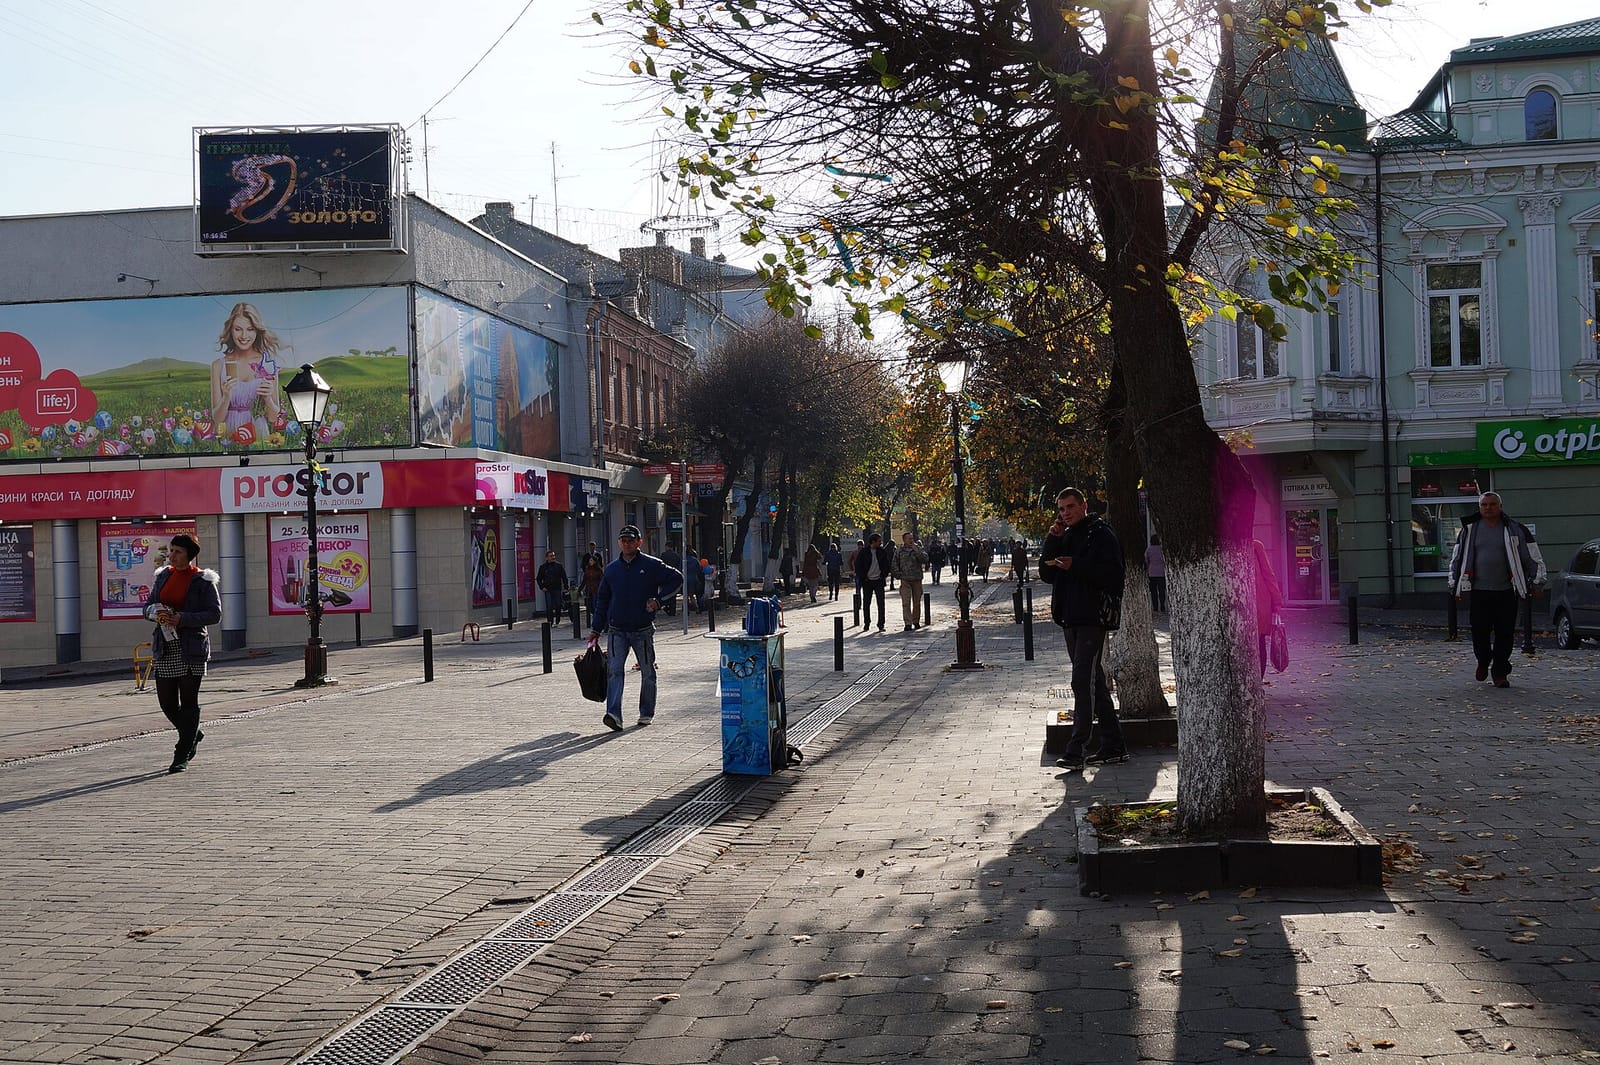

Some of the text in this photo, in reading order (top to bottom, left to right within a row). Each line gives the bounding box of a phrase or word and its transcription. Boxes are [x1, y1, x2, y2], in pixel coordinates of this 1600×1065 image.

[288, 209, 377, 224] ЗОЛОТО
[476, 464, 510, 474] proStor
[233, 468, 370, 507] proStor
[31, 491, 64, 503] КРАСИ
[69, 491, 82, 501] ТА
[86, 488, 136, 502] ДОГЛЯДУ
[251, 500, 290, 509] МАГАЗИНИ
[331, 498, 364, 506] ДОГЛЯДУ
[281, 527, 293, 536] 25
[316, 525, 359, 535] ЖОВТНЯ
[317, 540, 352, 553] ДЕКОР
